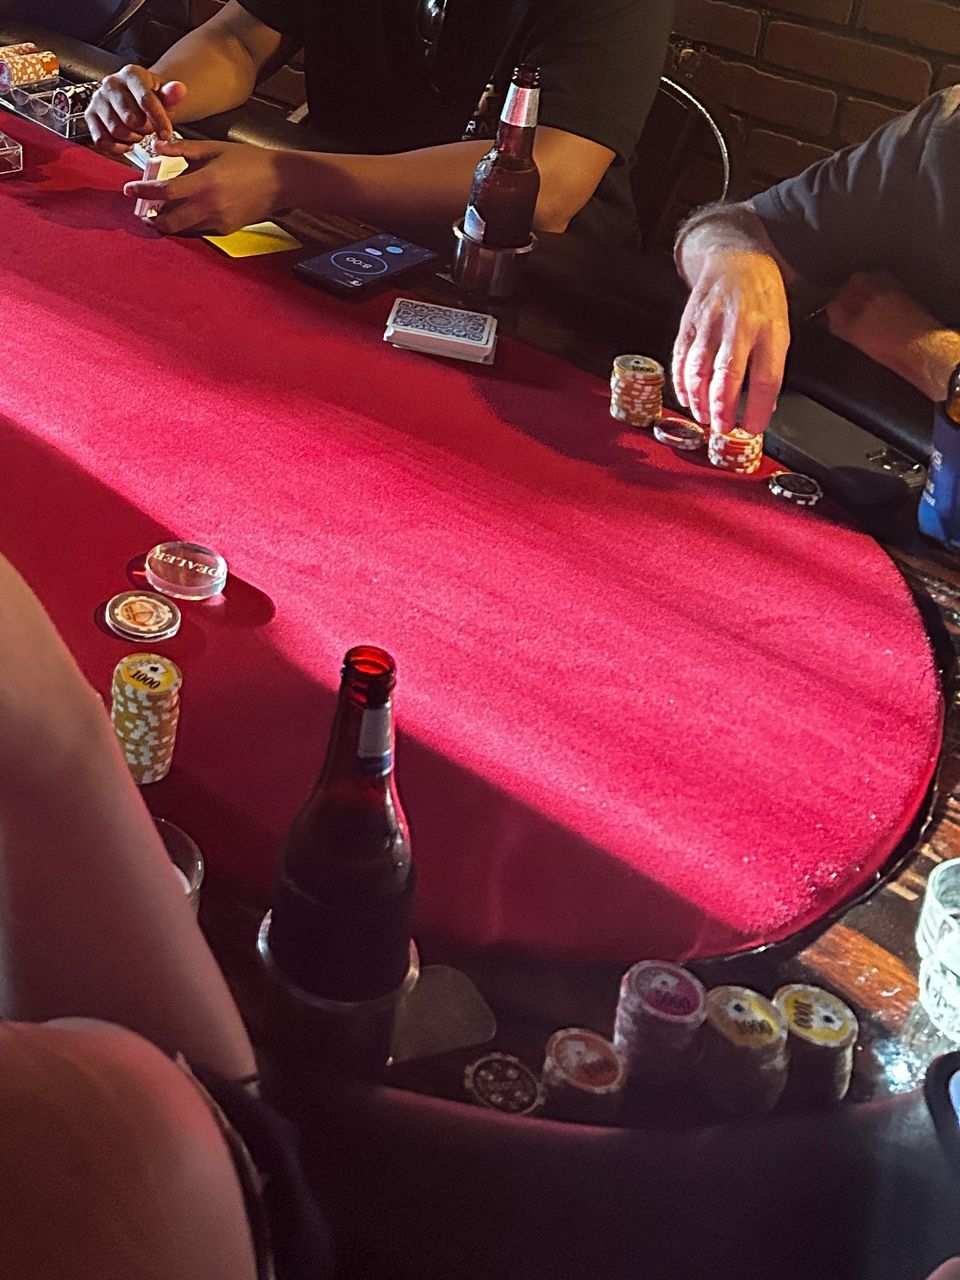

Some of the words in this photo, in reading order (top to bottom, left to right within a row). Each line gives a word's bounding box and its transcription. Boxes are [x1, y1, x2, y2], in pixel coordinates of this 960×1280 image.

[346, 256, 373, 269] 8:00
[152, 552, 218, 577] DEALER
[130, 670, 161, 689] 1000
